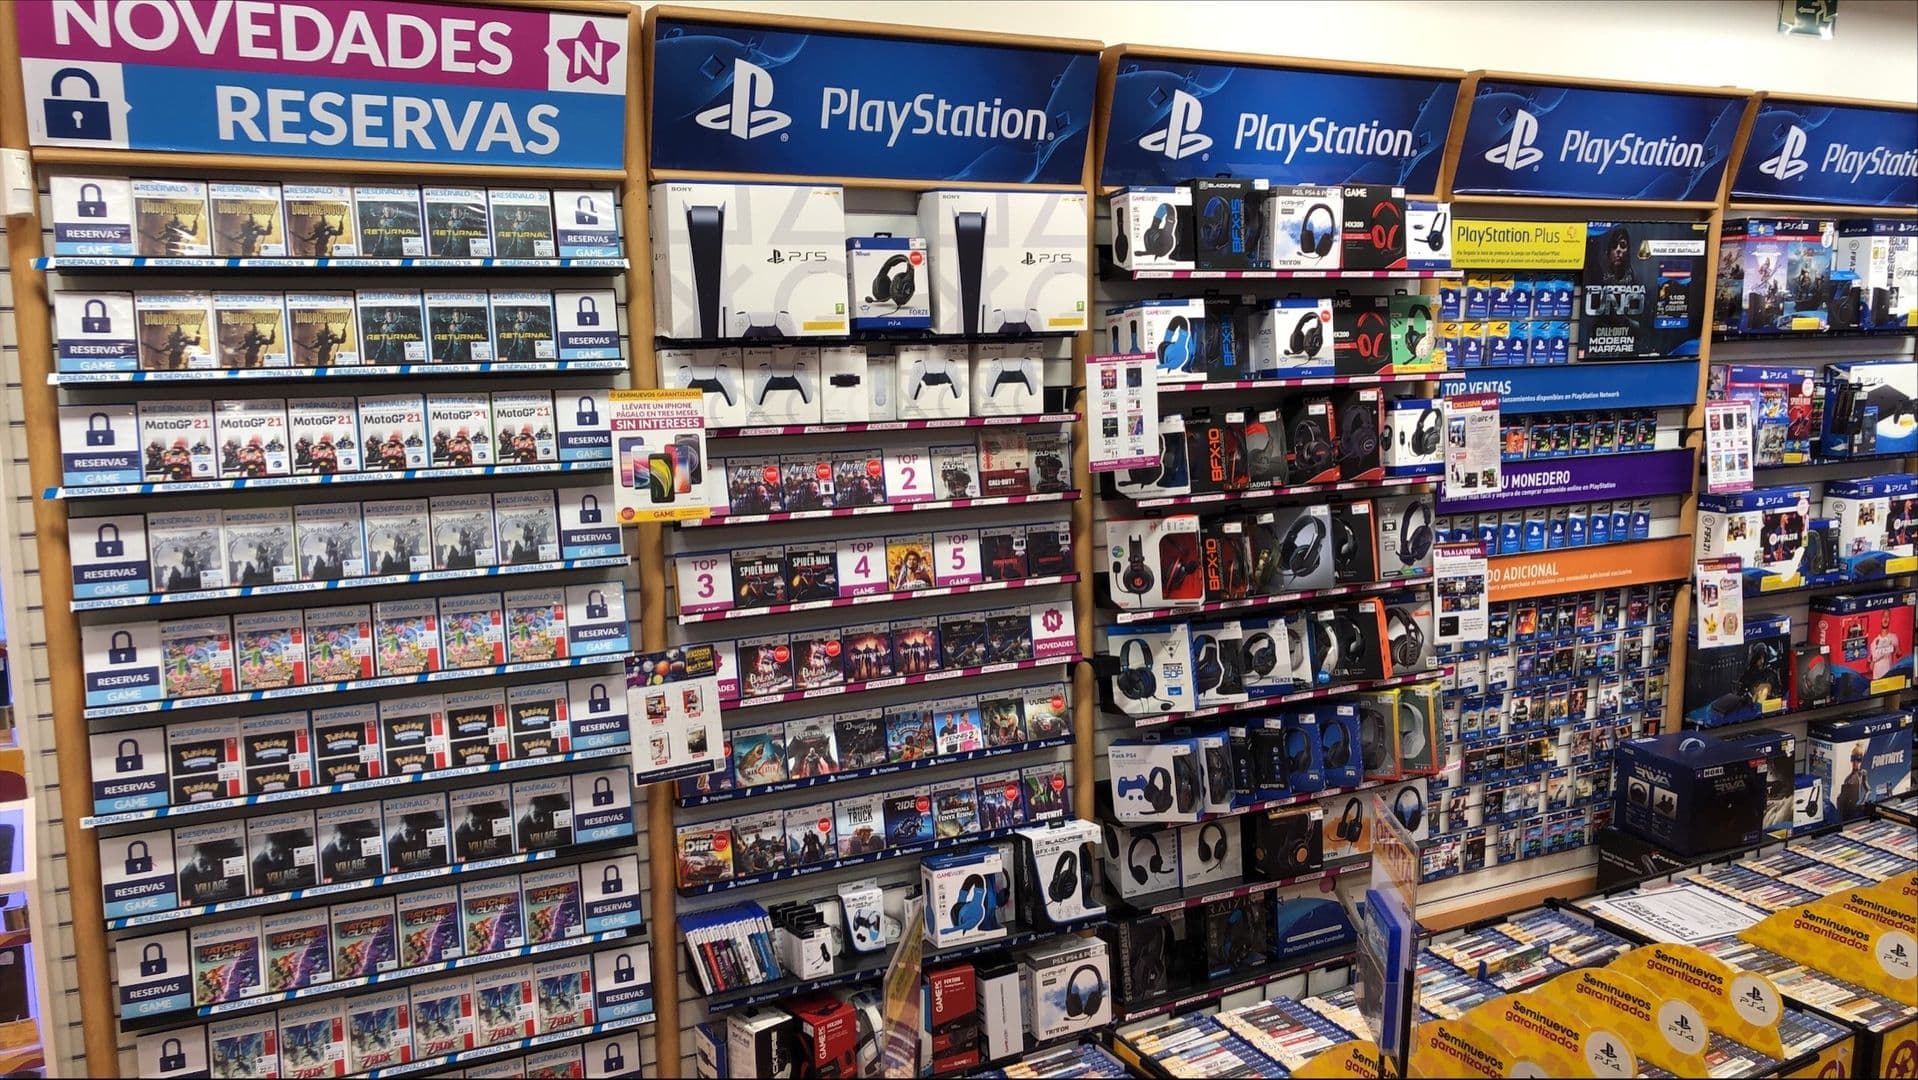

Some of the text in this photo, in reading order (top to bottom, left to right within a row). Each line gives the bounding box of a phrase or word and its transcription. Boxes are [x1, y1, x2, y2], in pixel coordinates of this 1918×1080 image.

[53, 0, 513, 76] NOVEDADES
[573, 40, 604, 76] N
[216, 85, 560, 155] RESERVAS
[821, 87, 1048, 147] PlayStation
[1234, 112, 1413, 164] PlayStation
[1559, 129, 1704, 175] PlayStation
[1344, 188, 1368, 198] GAME
[66, 229, 121, 240] RESERVAS
[364, 228, 418, 236] RETURNAL
[1457, 226, 1560, 247] PlayStation Plus
[567, 235, 608, 244] RESERVAS
[77, 245, 112, 255] GAME
[788, 252, 828, 262] PS5
[1039, 254, 1072, 264] PS5
[1585, 285, 1646, 294] TEMPORADA
[1586, 293, 1645, 316] UNO
[909, 308, 928, 316] FORZE
[367, 333, 420, 342] RETURNAL
[1589, 336, 1634, 345] MODERN
[1588, 344, 1634, 353] WARFARE
[80, 361, 116, 371] GAME
[1770, 371, 1788, 380] PS4
[1445, 380, 1512, 396] TOP VENTAS
[1572, 392, 1599, 400] PlayStation
[622, 402, 652, 410] LLÉVATE
[653, 402, 664, 410] UN
[496, 407, 550, 418] MotoGP 21
[616, 410, 645, 418] PÁGALO
[145, 418, 210, 430] MotoGP 21
[293, 415, 352, 426] MotoGP 21
[616, 418, 700, 430] SIN INTERESES
[568, 435, 609, 444] RESERVAS
[74, 457, 128, 468] RESERVAS
[896, 454, 918, 466] TOP
[901, 466, 917, 491] 2
[1512, 470, 1570, 488] MONEDERO
[1522, 490, 1542, 498] comprar
[1890, 484, 1908, 492] PS4
[1765, 496, 1784, 505] PS4
[654, 510, 676, 518] GAME
[572, 532, 612, 542] RESERVAS
[946, 534, 969, 546] TOP
[850, 542, 874, 553] TOP
[951, 547, 966, 570] 5
[691, 559, 718, 571] TOP
[854, 555, 871, 578] 4
[1503, 562, 1559, 580] ADICIONAL
[84, 567, 137, 580] RESERVAS
[697, 574, 715, 599] 3
[853, 586, 876, 596] GAME
[1046, 614, 1058, 626] N
[578, 628, 619, 640] RESERVAS
[1036, 640, 1074, 650] NOVEDADES
[97, 673, 150, 686] RESERVAS
[108, 690, 142, 701] GAME
[806, 688, 842, 696] NOVEDADES
[742, 695, 779, 706] NOVEDADES
[1872, 750, 1904, 768] FORTNITE
[104, 780, 156, 795] RESERVAS
[896, 800, 915, 811] RIDE
[584, 812, 624, 826] RESERVAS
[848, 808, 873, 822] TRUCK
[335, 858, 367, 872] VILLAGE
[114, 882, 165, 898] RESERVAS
[194, 880, 228, 892] VILLAGE
[1850, 894, 1917, 924] Seminuevos
[1802, 910, 1870, 942] Seminuevos
[1794, 918, 1869, 952] garantizados
[1654, 950, 1724, 985] Seminuevos
[1646, 958, 1723, 996] garantizados
[1583, 972, 1652, 1011] Seminuevos
[1576, 983, 1651, 1022] garantizados
[1740, 996, 1768, 1014] PS4
[1512, 1001, 1580, 1041] Seminuevos
[1505, 1010, 1579, 1052] garantizados
[1668, 1025, 1697, 1044] PS4
[1437, 1026, 1504, 1071] Seminuevos
